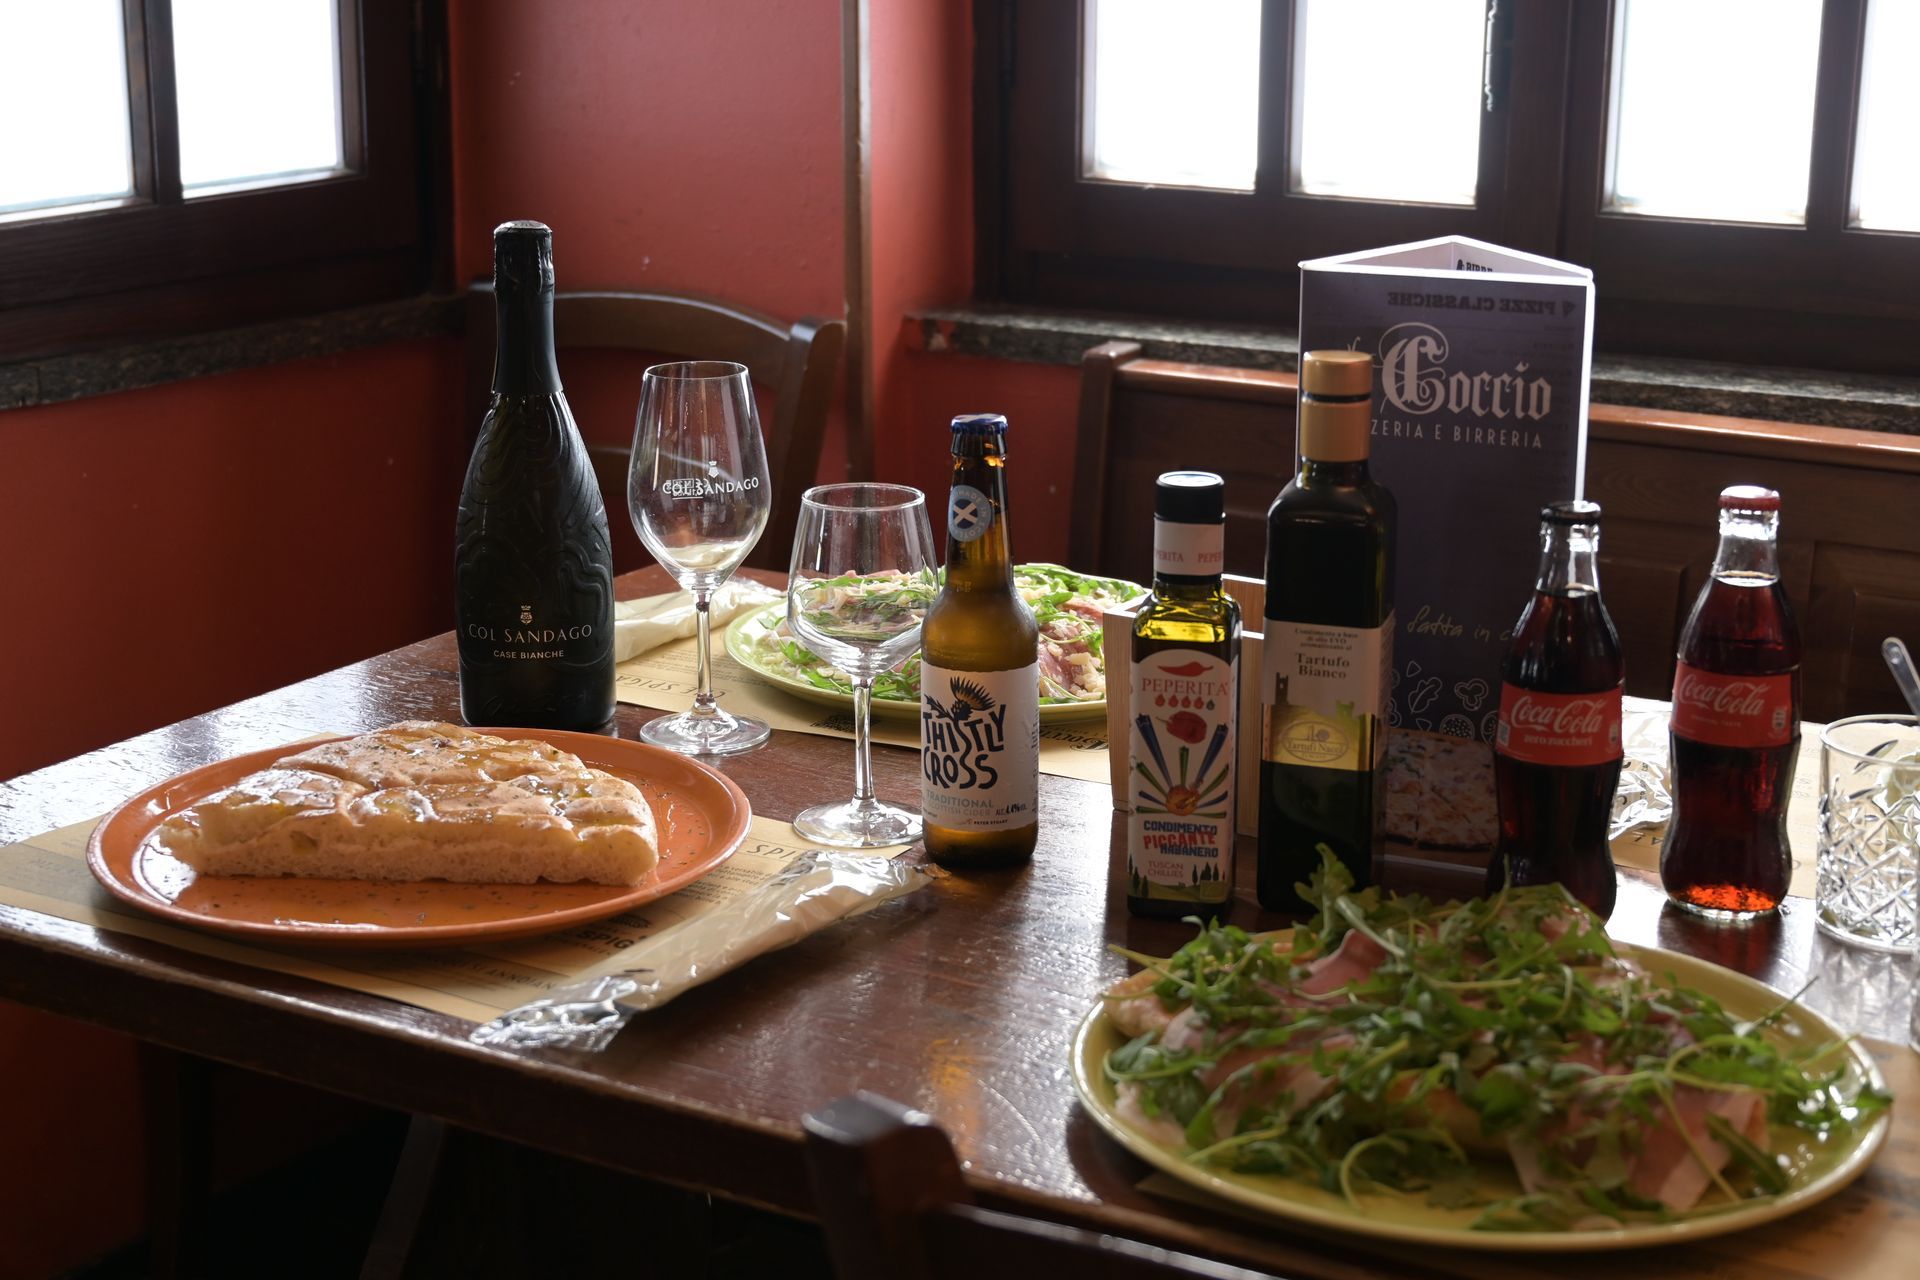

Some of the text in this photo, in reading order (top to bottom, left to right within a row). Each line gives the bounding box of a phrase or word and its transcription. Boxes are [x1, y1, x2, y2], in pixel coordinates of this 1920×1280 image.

[1378, 322, 1552, 421] Coccio
[1435, 424, 1442, 440] E
[1454, 426, 1542, 449] BIRRERIA
[697, 477, 759, 496] SANDAGO
[469, 623, 593, 644] COL SANDAGO
[493, 649, 565, 660] CASE BIANCHE
[1296, 652, 1350, 668] Tartufo
[1298, 665, 1346, 679] Bianco
[1678, 673, 1772, 716] Coca-Cola
[1511, 695, 1606, 735] Coca-Cola
[923, 704, 1007, 753] THISTLY
[1524, 735, 1548, 746] zero
[923, 744, 998, 790] CROSS
[926, 788, 993, 808] TRADITIONAL
[1143, 820, 1218, 836] CONDIMENTO
[1143, 831, 1216, 849] PICCANTE
[1148, 860, 1184, 870] TUSCAN
[576, 930, 648, 949] SPIG
